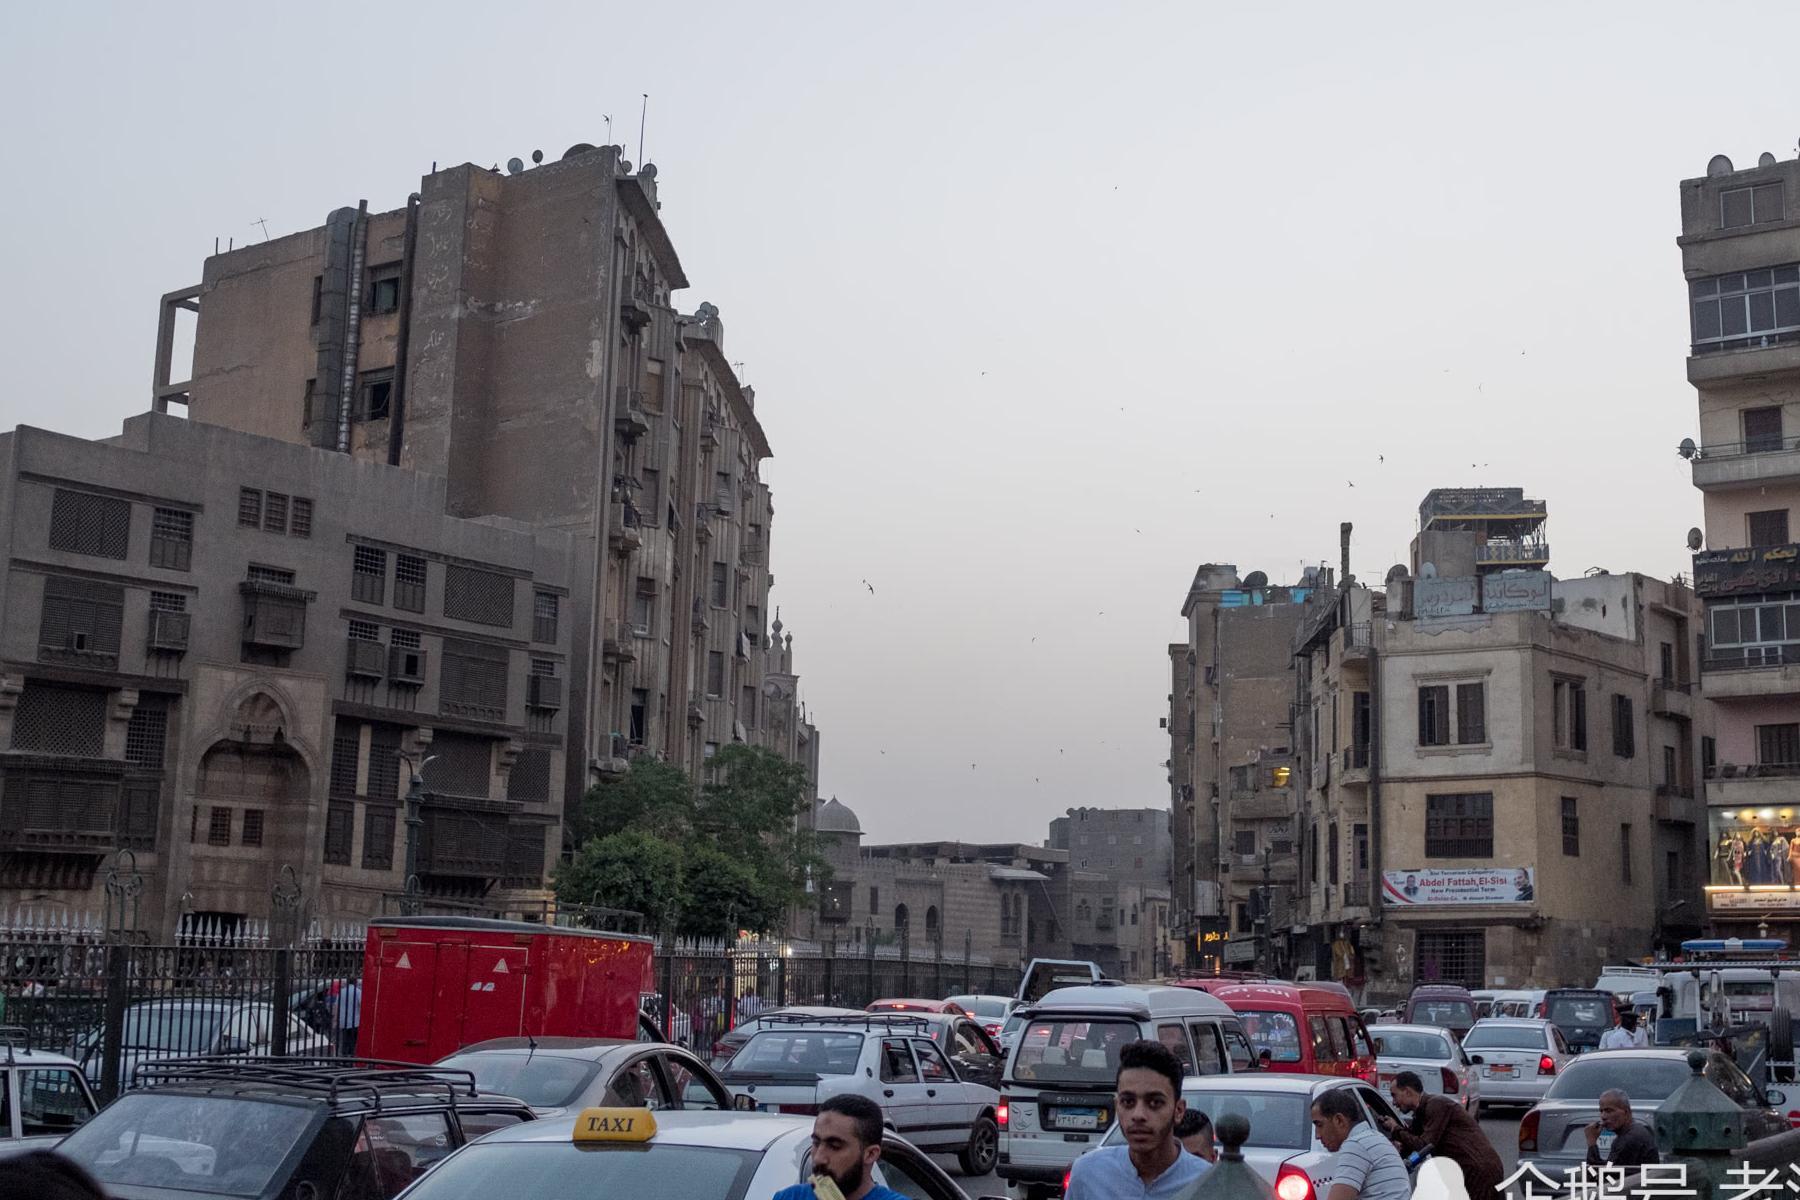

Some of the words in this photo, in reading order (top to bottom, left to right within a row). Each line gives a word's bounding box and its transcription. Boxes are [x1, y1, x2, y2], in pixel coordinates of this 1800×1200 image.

[1419, 878, 1445, 887] Abdel
[1478, 876, 1507, 886] El-Sisi
[588, 1116, 635, 1132] TAXI
